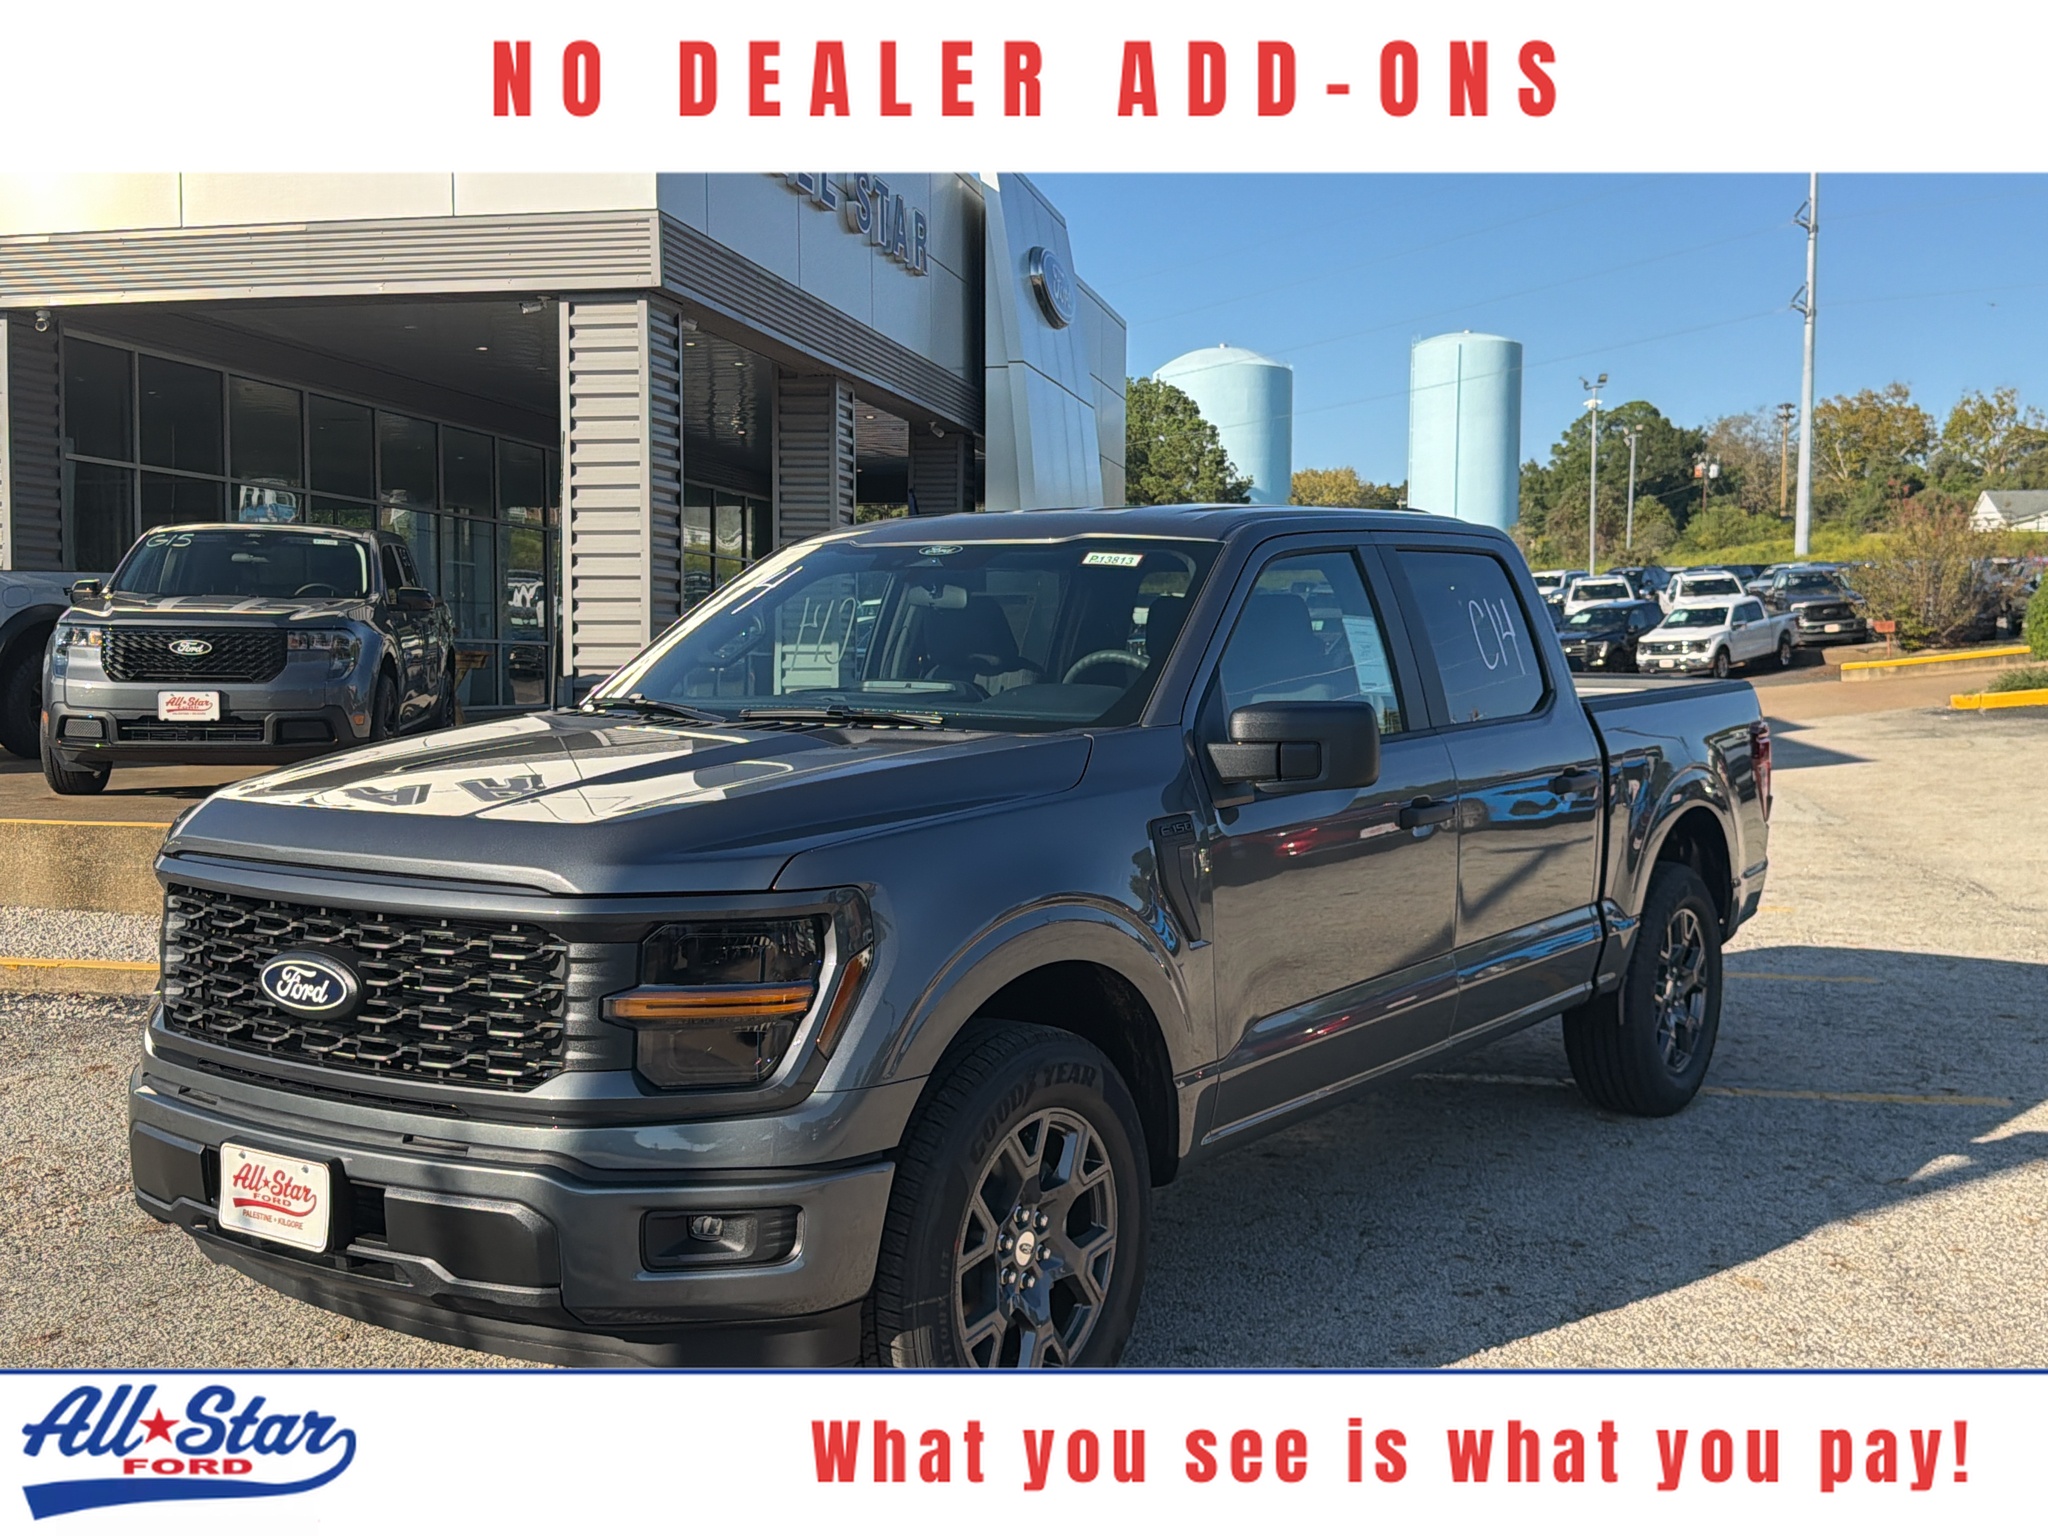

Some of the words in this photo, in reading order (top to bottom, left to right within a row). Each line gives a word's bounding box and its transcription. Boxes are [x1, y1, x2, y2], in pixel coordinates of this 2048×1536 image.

[849, 173, 928, 276] STAR
[177, 642, 205, 653] Ford
[276, 966, 330, 1004] Ford
[232, 1163, 265, 1192] All
[270, 1169, 317, 1203] Star
[252, 1192, 292, 1207] FORD
[242, 1208, 273, 1223] PALESTINE
[277, 1217, 304, 1231] KILGORE
